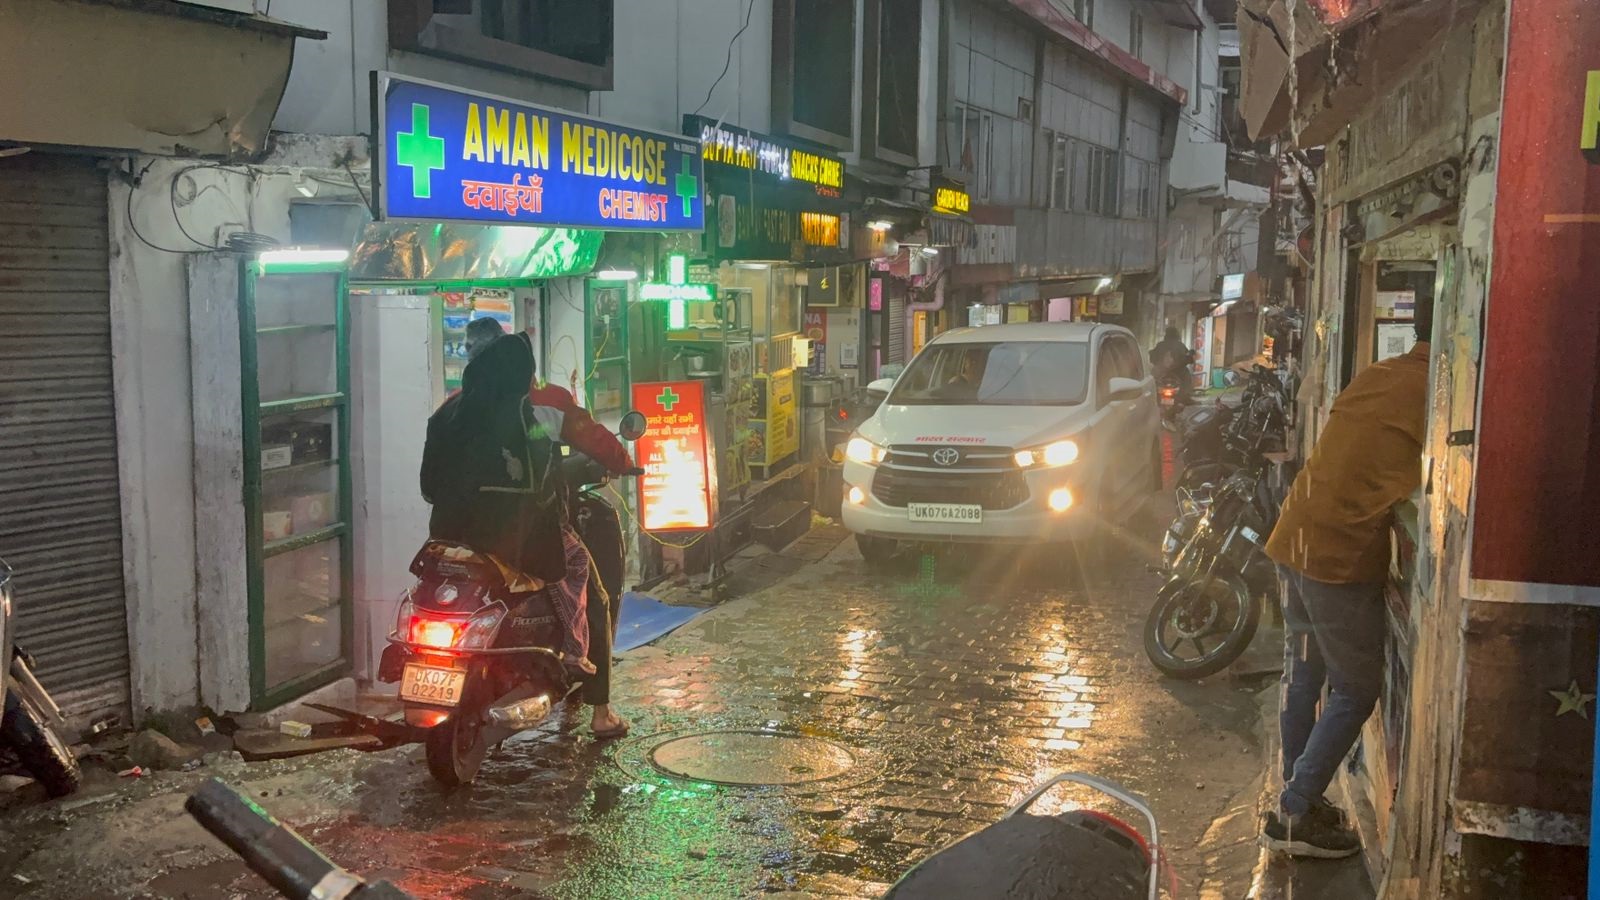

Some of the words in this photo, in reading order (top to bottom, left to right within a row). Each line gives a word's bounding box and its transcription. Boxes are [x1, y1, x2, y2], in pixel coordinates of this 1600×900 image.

[462, 102, 549, 170] AMAN
[561, 121, 667, 185] MEDICOSE
[791, 149, 818, 184] SNACKS
[461, 173, 543, 216] दवाईयाँ
[599, 187, 668, 222] CHEMIST
